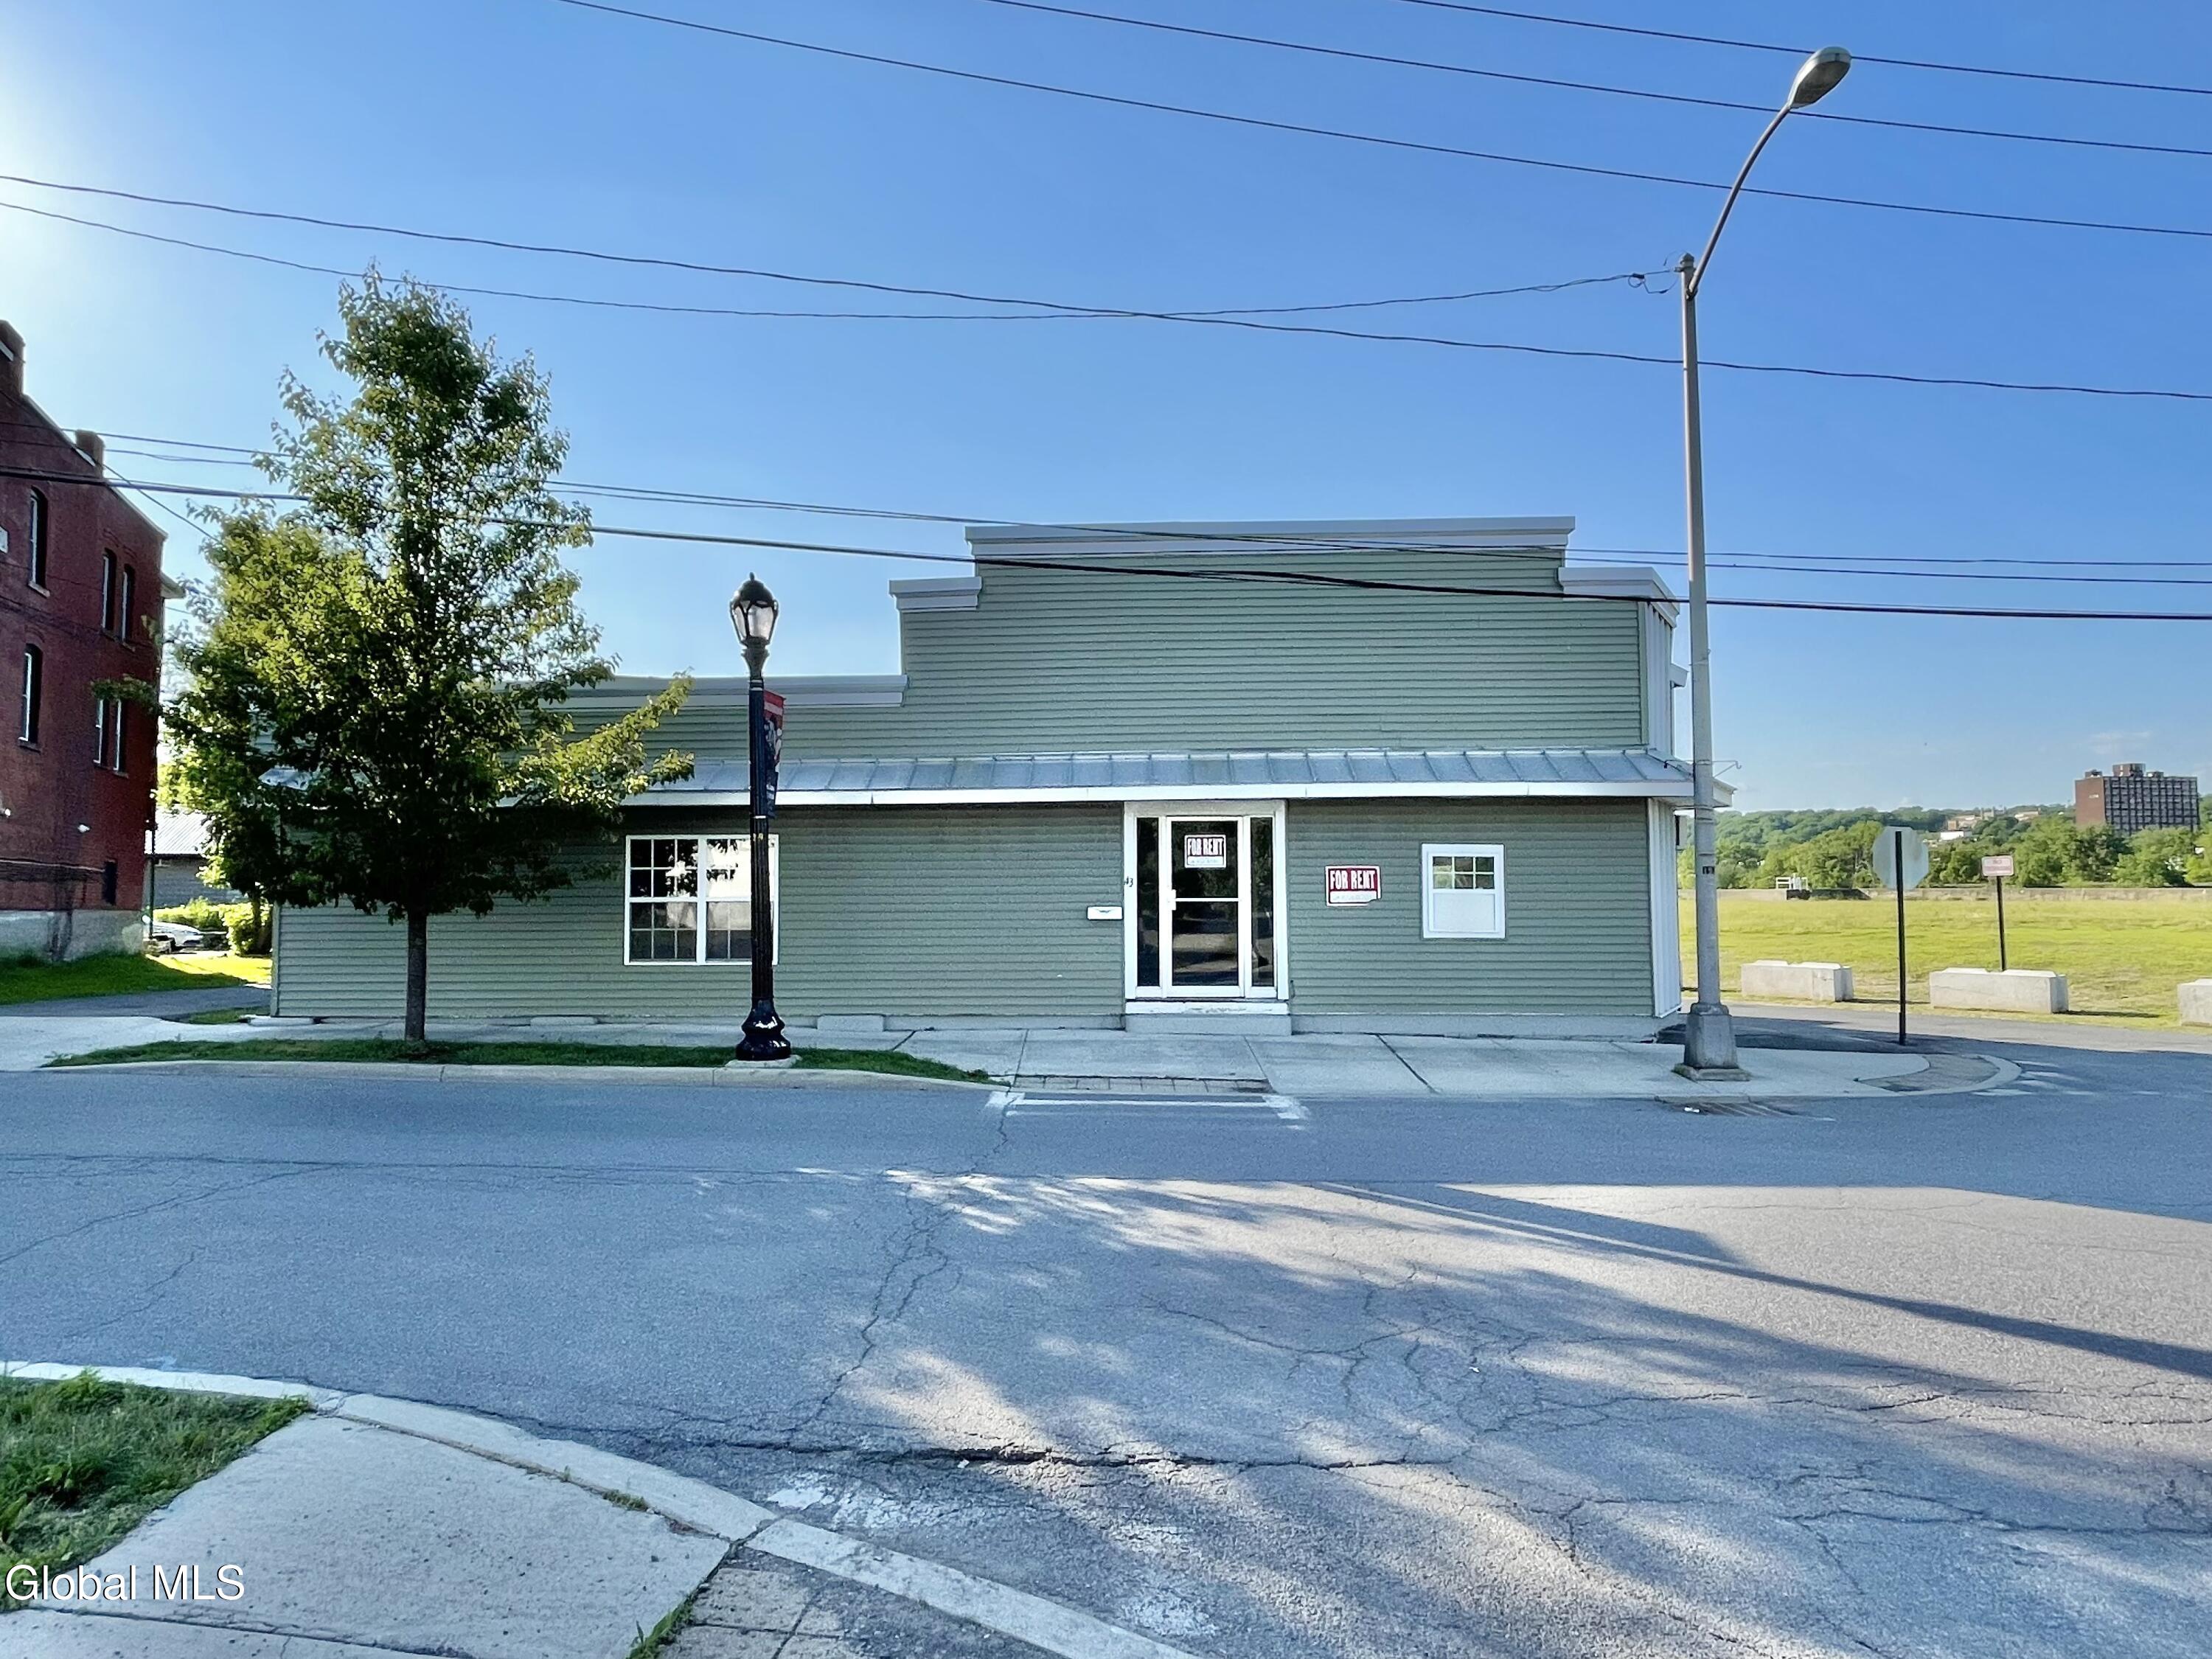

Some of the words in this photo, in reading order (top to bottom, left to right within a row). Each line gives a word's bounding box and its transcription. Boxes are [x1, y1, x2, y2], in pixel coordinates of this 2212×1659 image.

[1187, 838, 1202, 856] FOR
[1203, 838, 1223, 856] RENT
[1329, 870, 1349, 890] FOR
[1350, 870, 1376, 890] RENT
